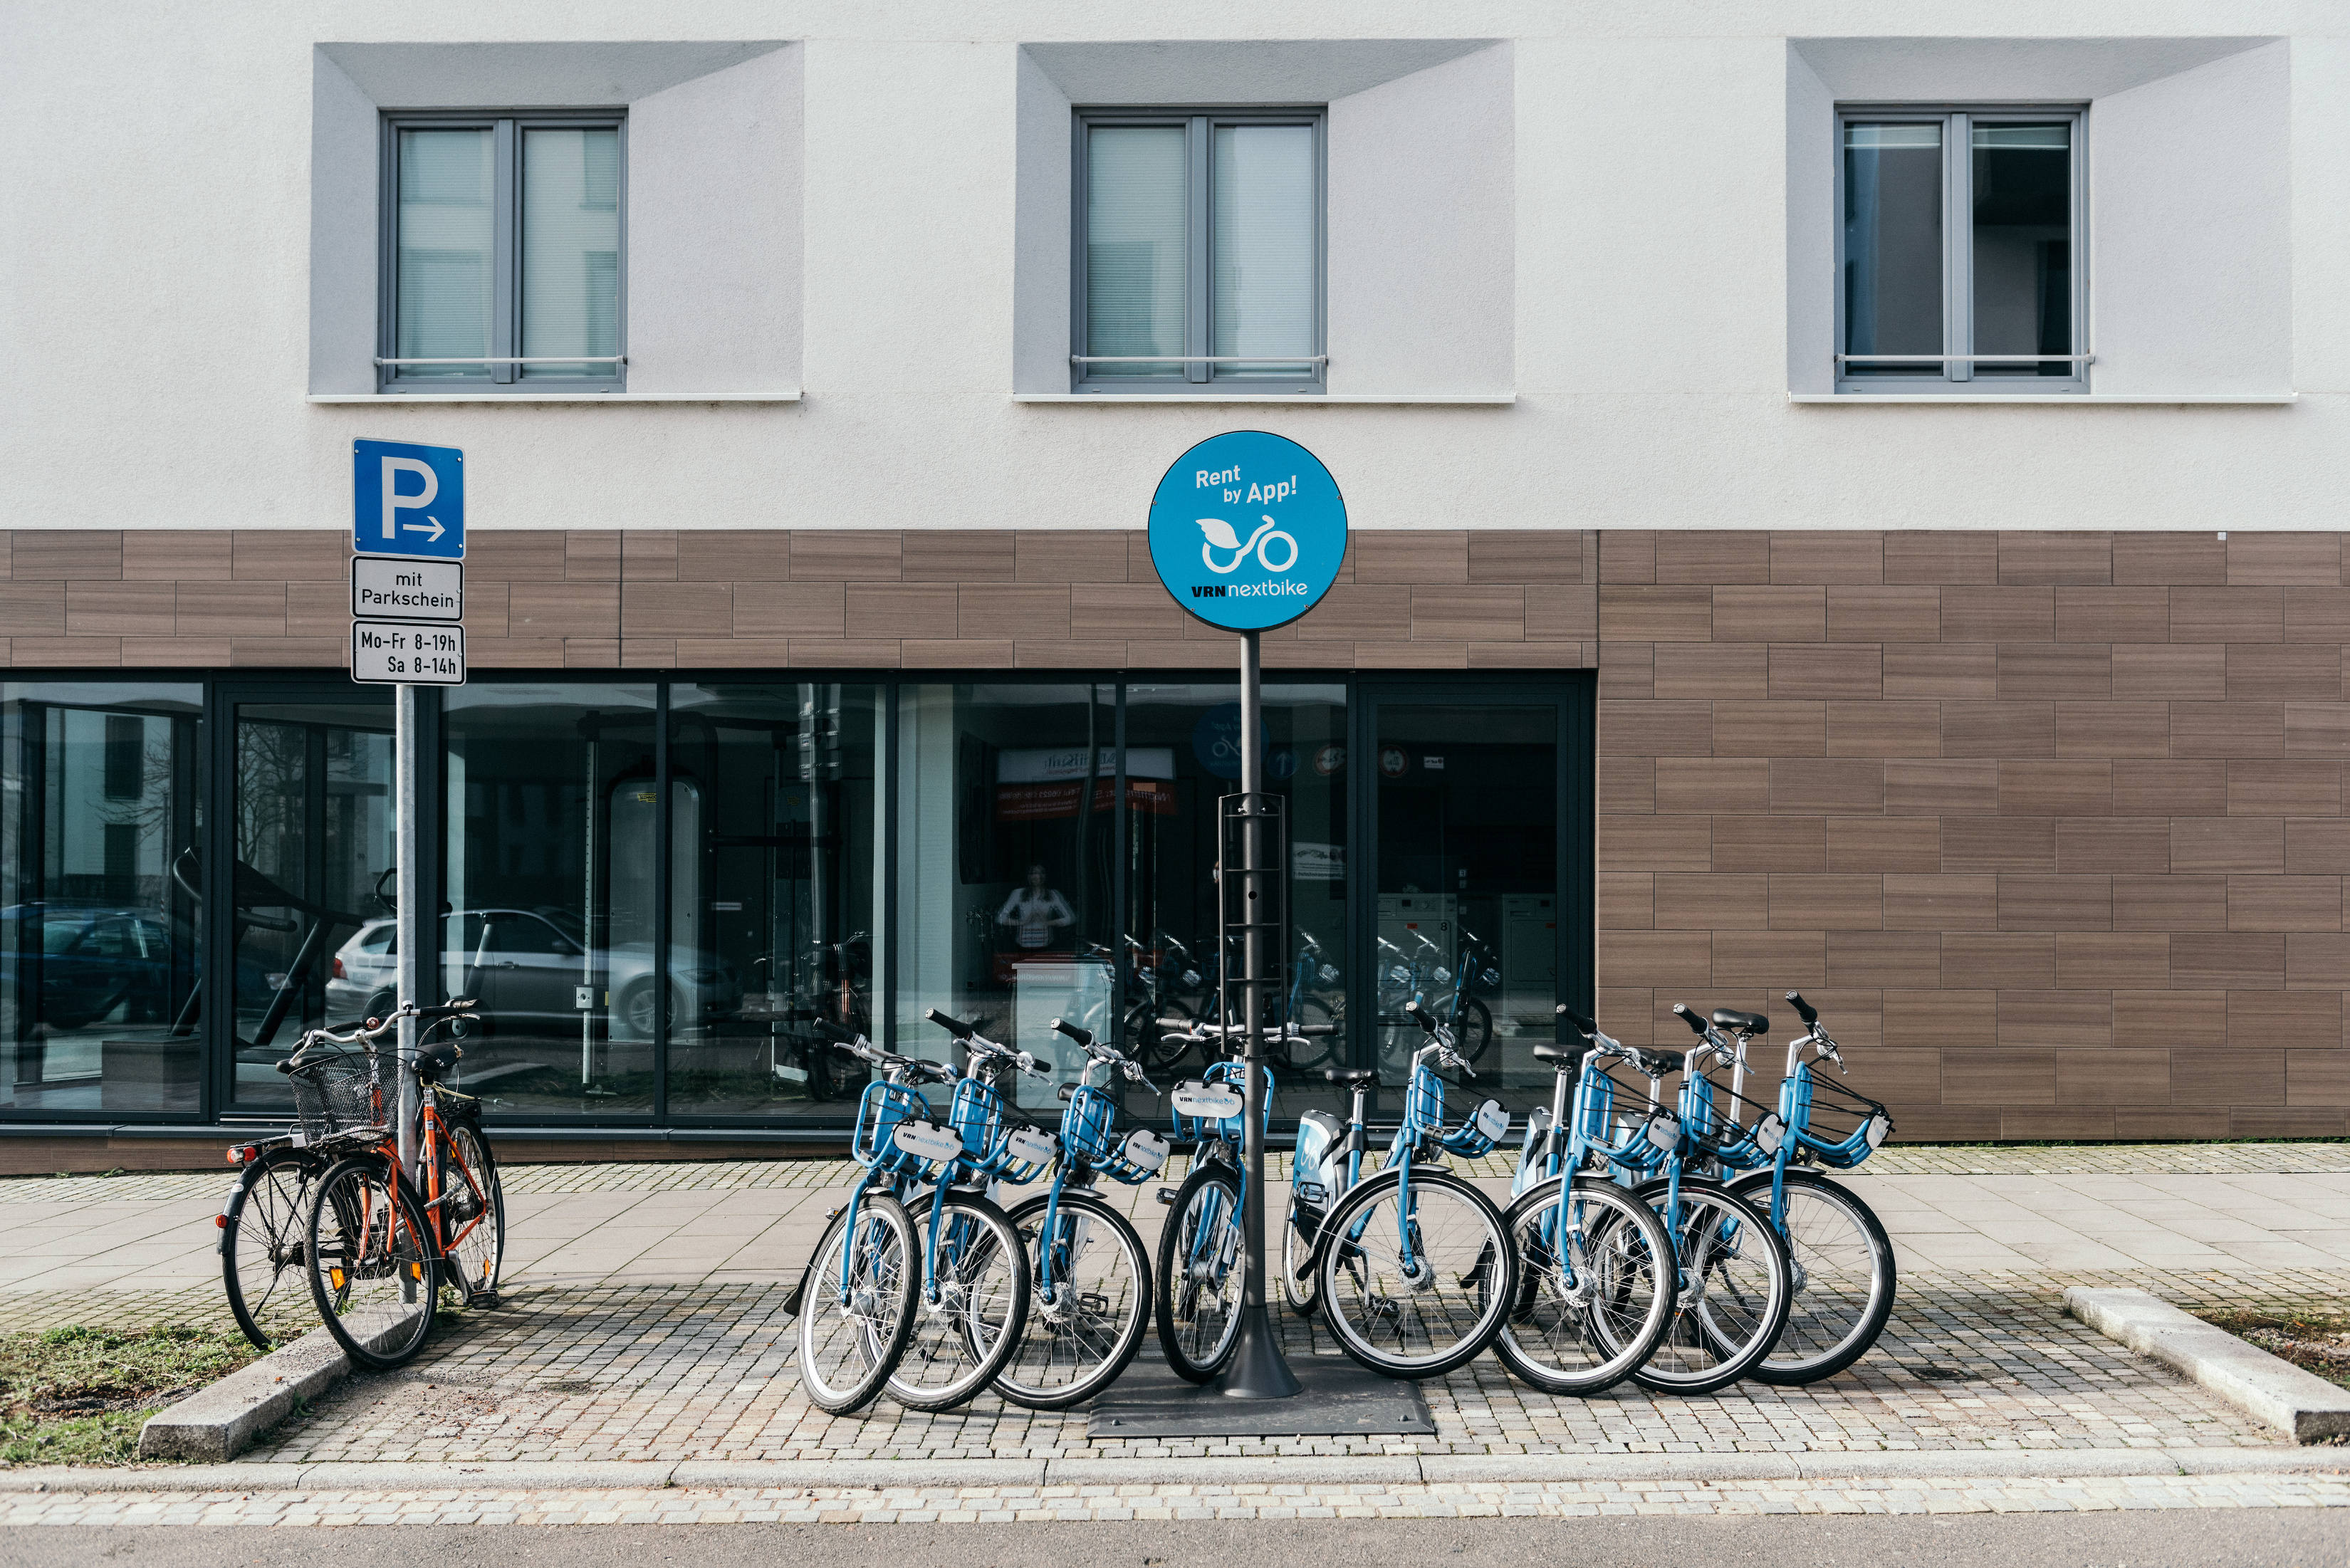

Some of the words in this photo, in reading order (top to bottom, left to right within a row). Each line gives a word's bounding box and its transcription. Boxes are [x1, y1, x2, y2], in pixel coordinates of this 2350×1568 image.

[1196, 465, 1241, 488] Rent
[381, 456, 439, 539] P
[1223, 488, 1242, 504] by
[1246, 475, 1297, 505] App!
[396, 573, 422, 587] mit
[362, 588, 454, 608] Parkschein
[361, 631, 406, 649] Mo-Fr
[414, 633, 456, 652] 8-19h
[387, 656, 405, 673] Sa
[414, 657, 456, 674] 8-14h
[1441, 922, 1448, 931] 8
